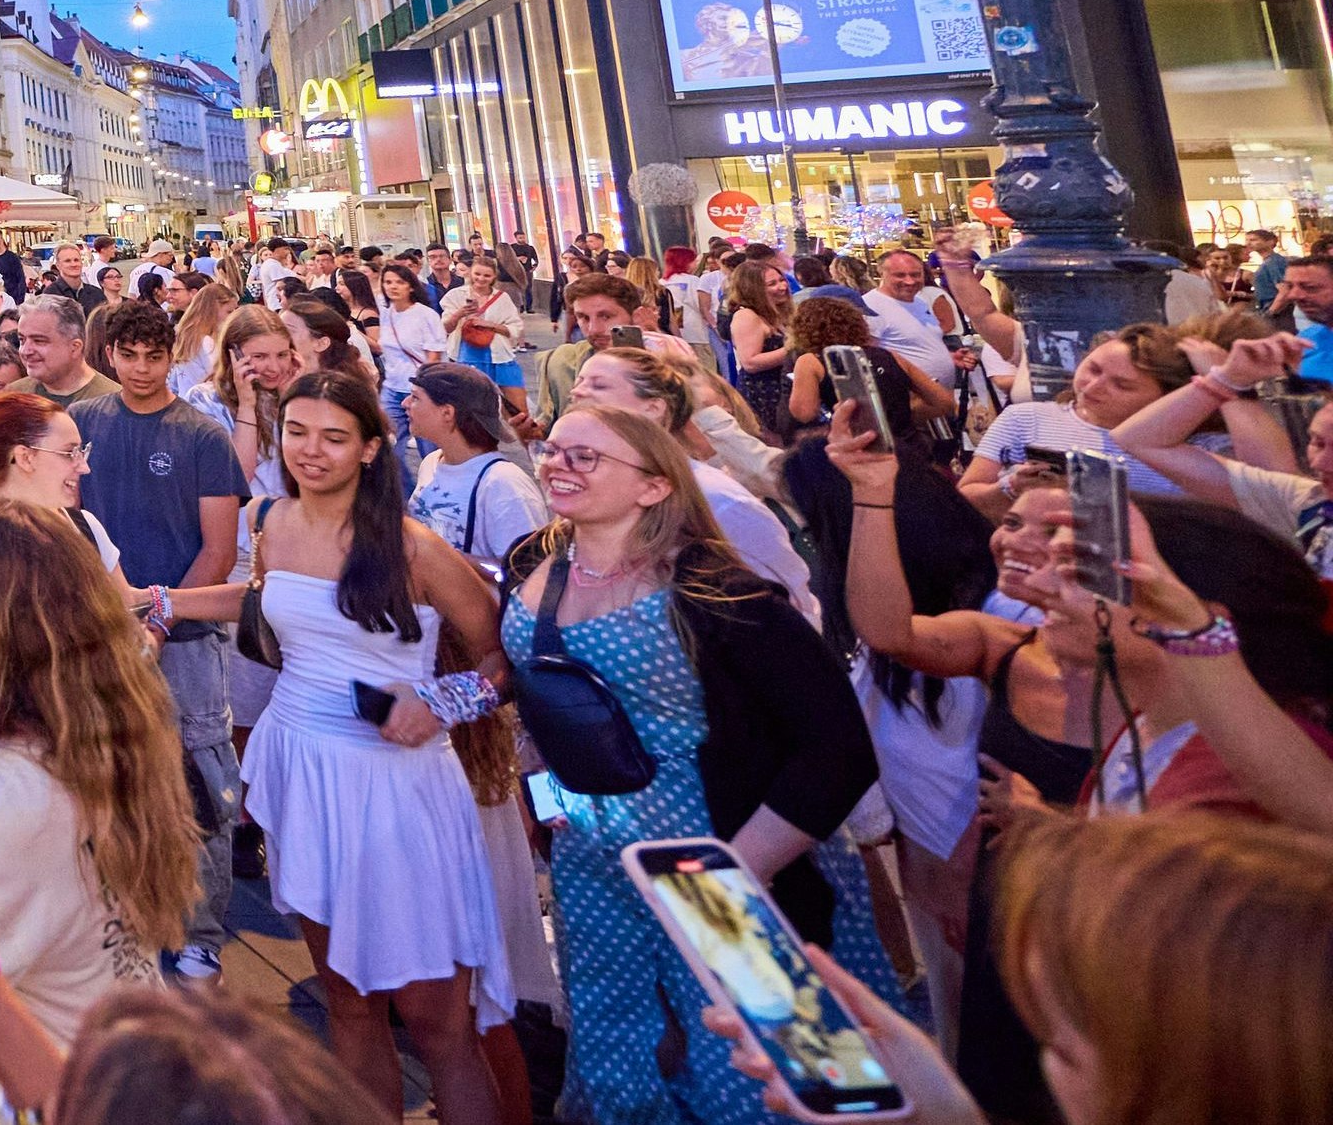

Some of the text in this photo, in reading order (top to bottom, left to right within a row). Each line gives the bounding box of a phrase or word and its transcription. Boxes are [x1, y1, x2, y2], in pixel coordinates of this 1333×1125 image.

[819, 6, 898, 19] THE ORIGINAL
[723, 99, 967, 145] HUMANIC
[972, 196, 998, 210] SA
